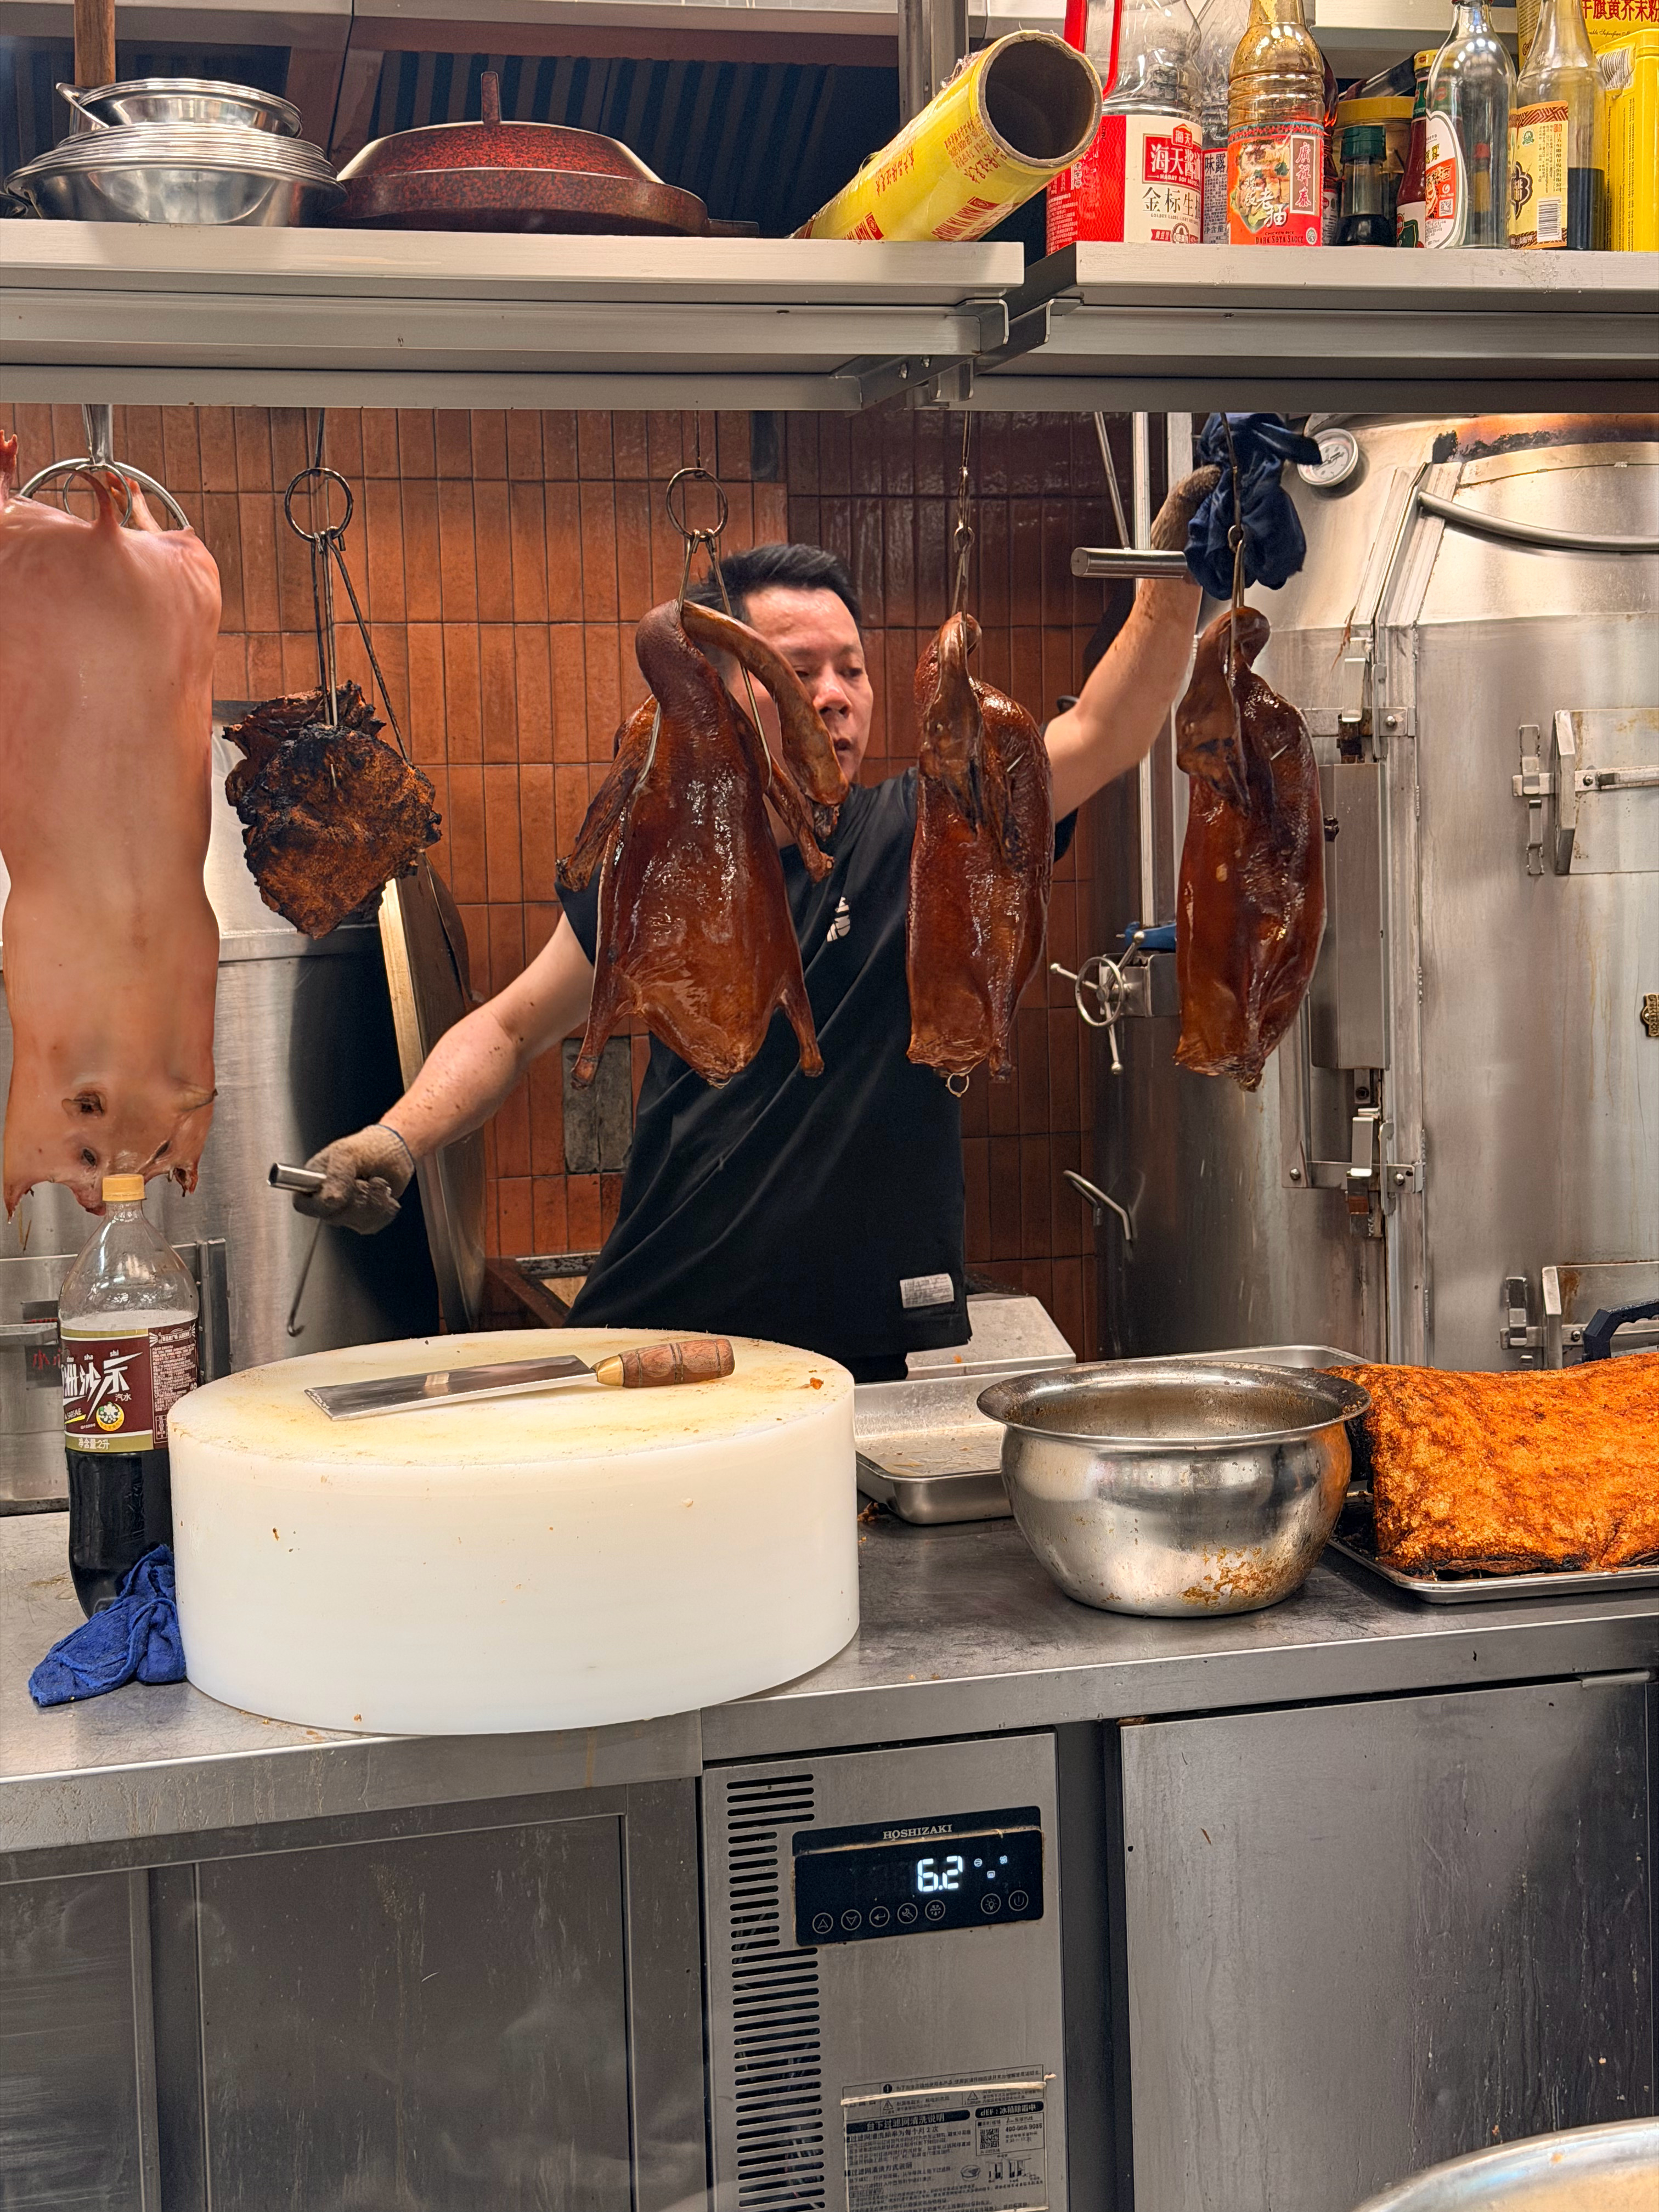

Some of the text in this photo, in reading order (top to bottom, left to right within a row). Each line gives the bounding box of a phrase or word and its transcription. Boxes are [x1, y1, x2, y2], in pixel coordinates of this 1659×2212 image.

[1175, 129, 1192, 147] 海天
[1271, 235, 1286, 244] SOYA
[115, 1393, 132, 1402] 汽水
[882, 1824, 953, 1840] HOSHIZAKI
[917, 1855, 964, 1892] 6.2
